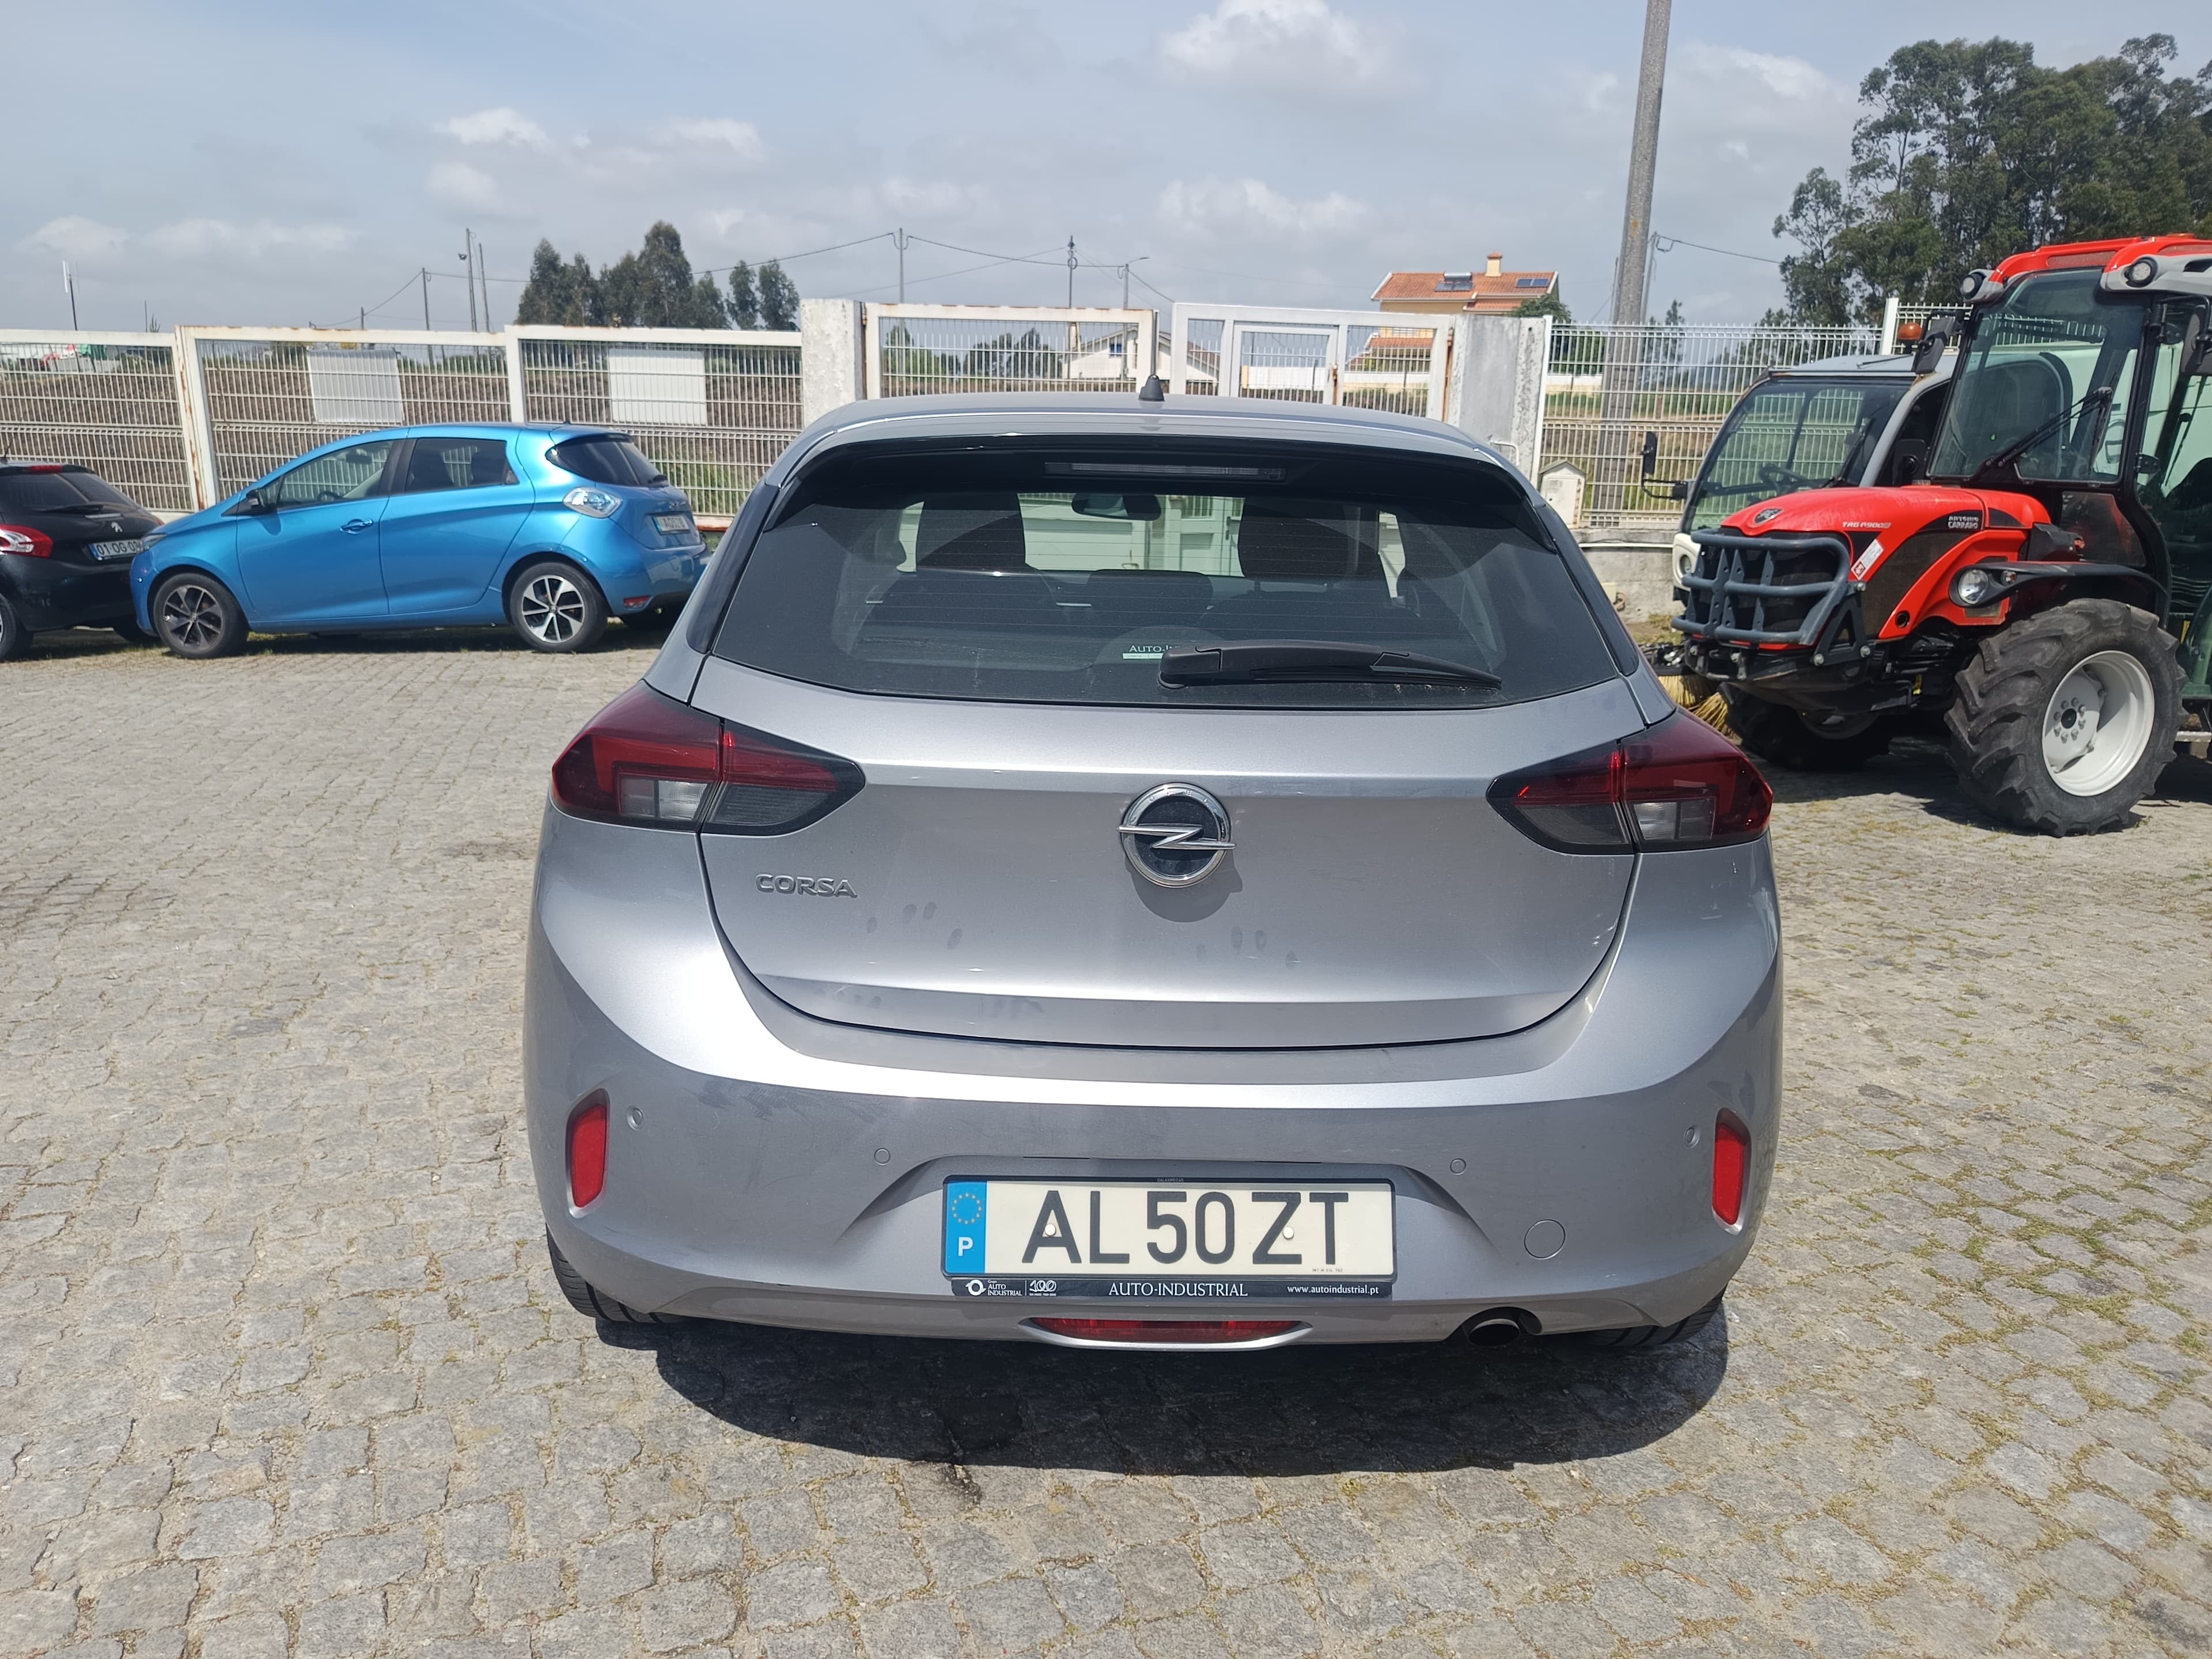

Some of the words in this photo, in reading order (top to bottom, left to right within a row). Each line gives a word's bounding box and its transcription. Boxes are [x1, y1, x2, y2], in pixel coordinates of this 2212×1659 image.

[755, 873, 858, 898] CORSA
[1022, 1190, 1130, 1264] AL
[1147, 1191, 1235, 1264] 50
[1252, 1192, 1349, 1265] ZT
[958, 1237, 973, 1257] P
[1029, 1280, 1057, 1292] 100
[1108, 1283, 1248, 1296] AUTO-INDUSTRIAL
[1287, 1285, 1379, 1295] www.autoindustrial.pt
